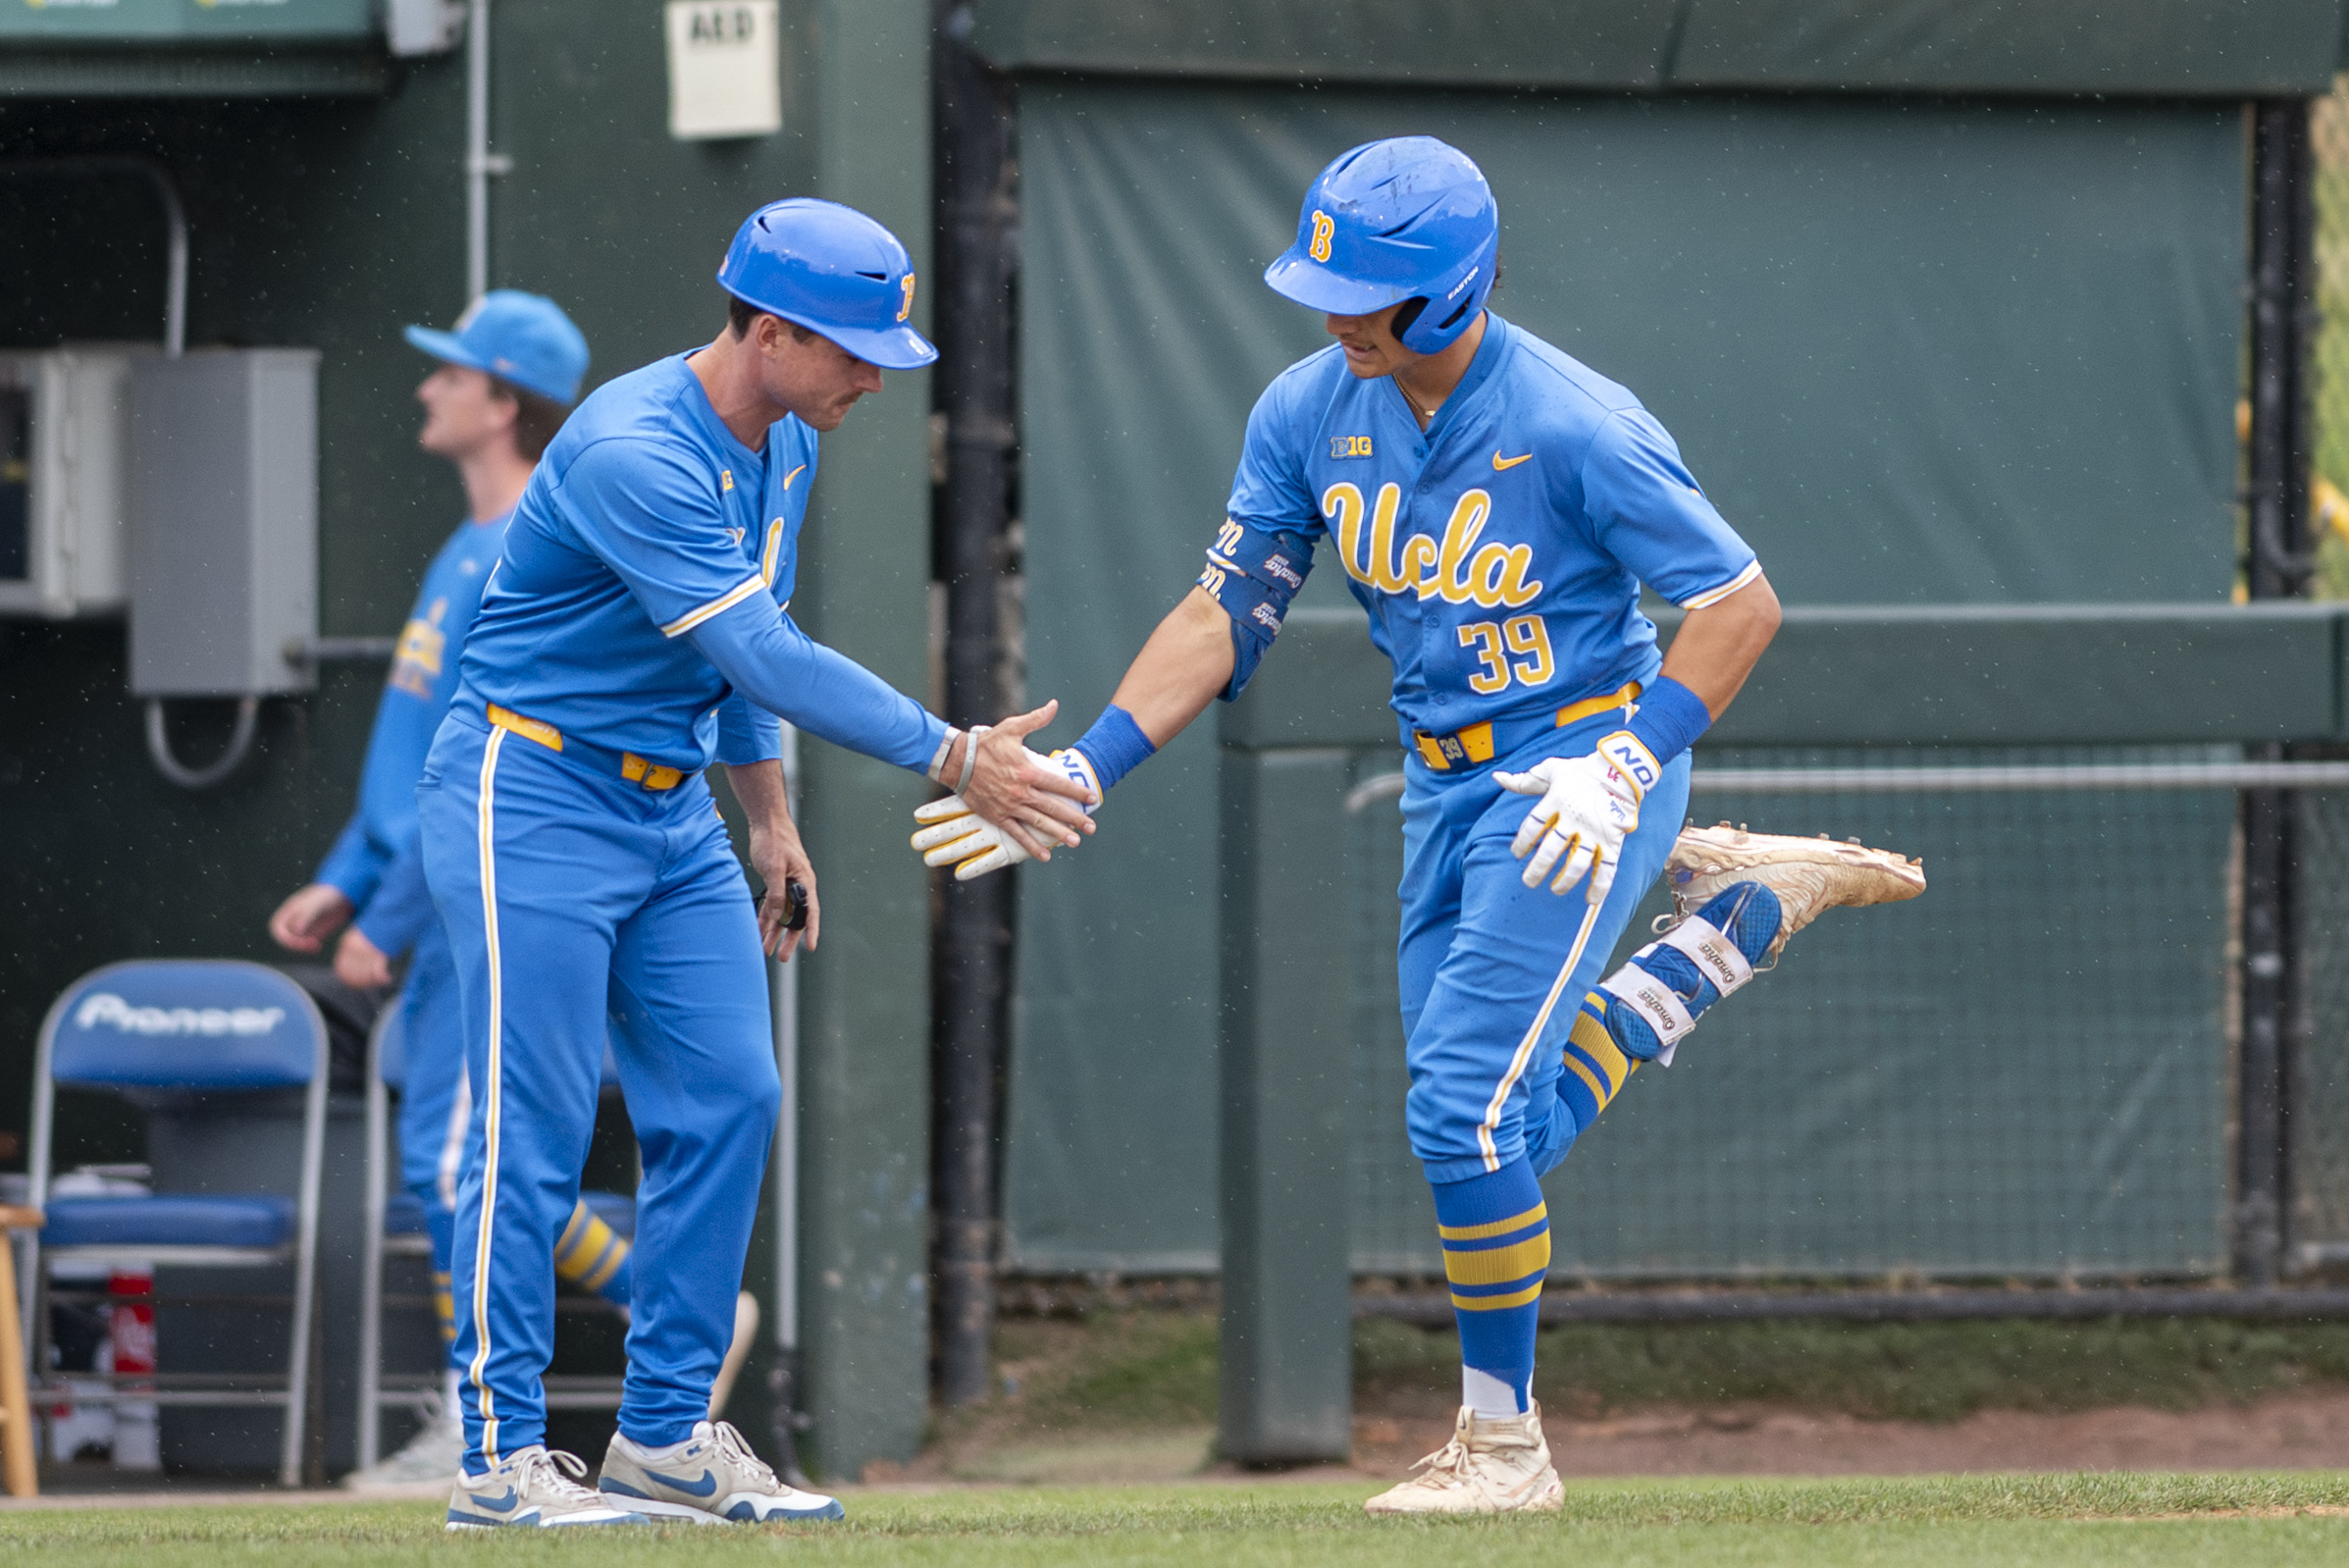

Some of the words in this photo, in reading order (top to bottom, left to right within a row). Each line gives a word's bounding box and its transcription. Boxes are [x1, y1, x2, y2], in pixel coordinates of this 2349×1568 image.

[690, 8, 755, 43] AED
[1310, 209, 1334, 263] B
[1322, 481, 1543, 609] Ucla
[1456, 613, 1555, 696] 39
[1438, 737, 1465, 760] 39
[1699, 941, 1736, 984] Omaha
[76, 993, 286, 1037] Pioneer
[1639, 989, 1676, 1030] Omaha
